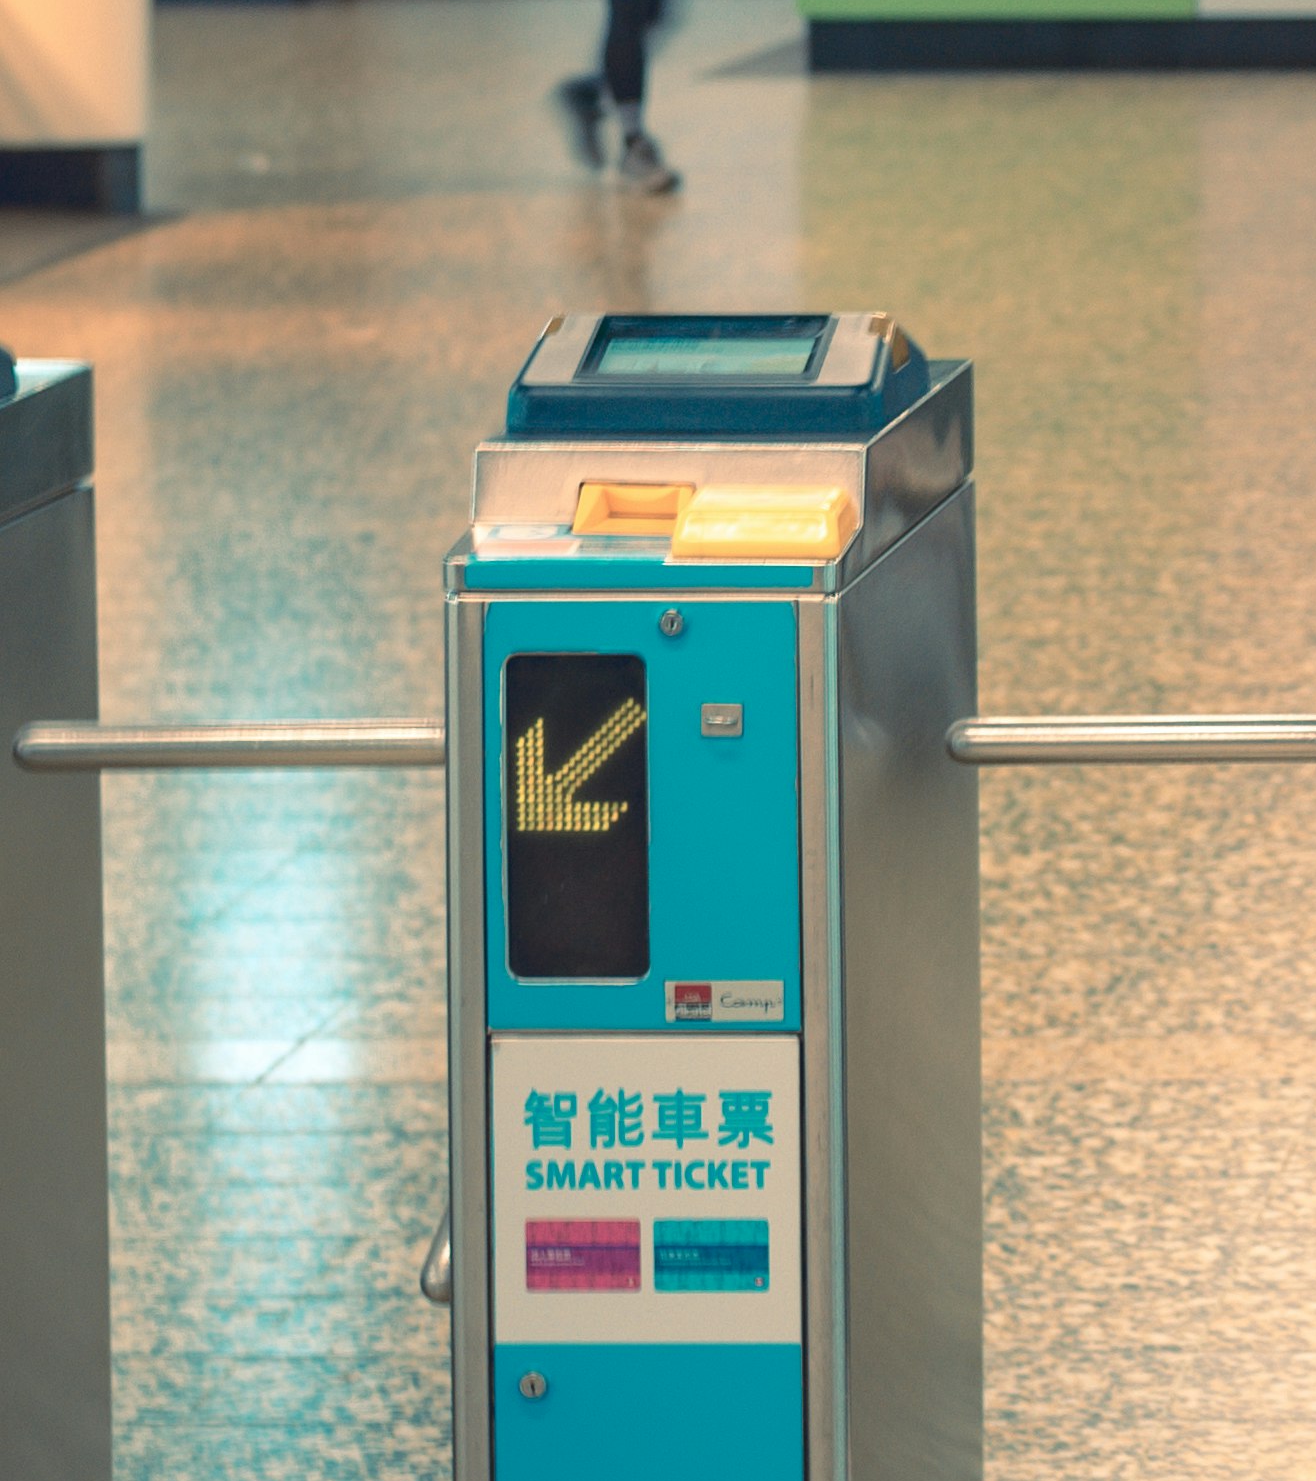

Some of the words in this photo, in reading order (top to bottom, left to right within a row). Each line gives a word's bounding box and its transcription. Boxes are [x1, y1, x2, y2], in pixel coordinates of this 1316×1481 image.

[524, 1087, 774, 1151] 智能車票
[525, 1160, 646, 1191] SMART
[653, 1160, 771, 1191] TICKET
